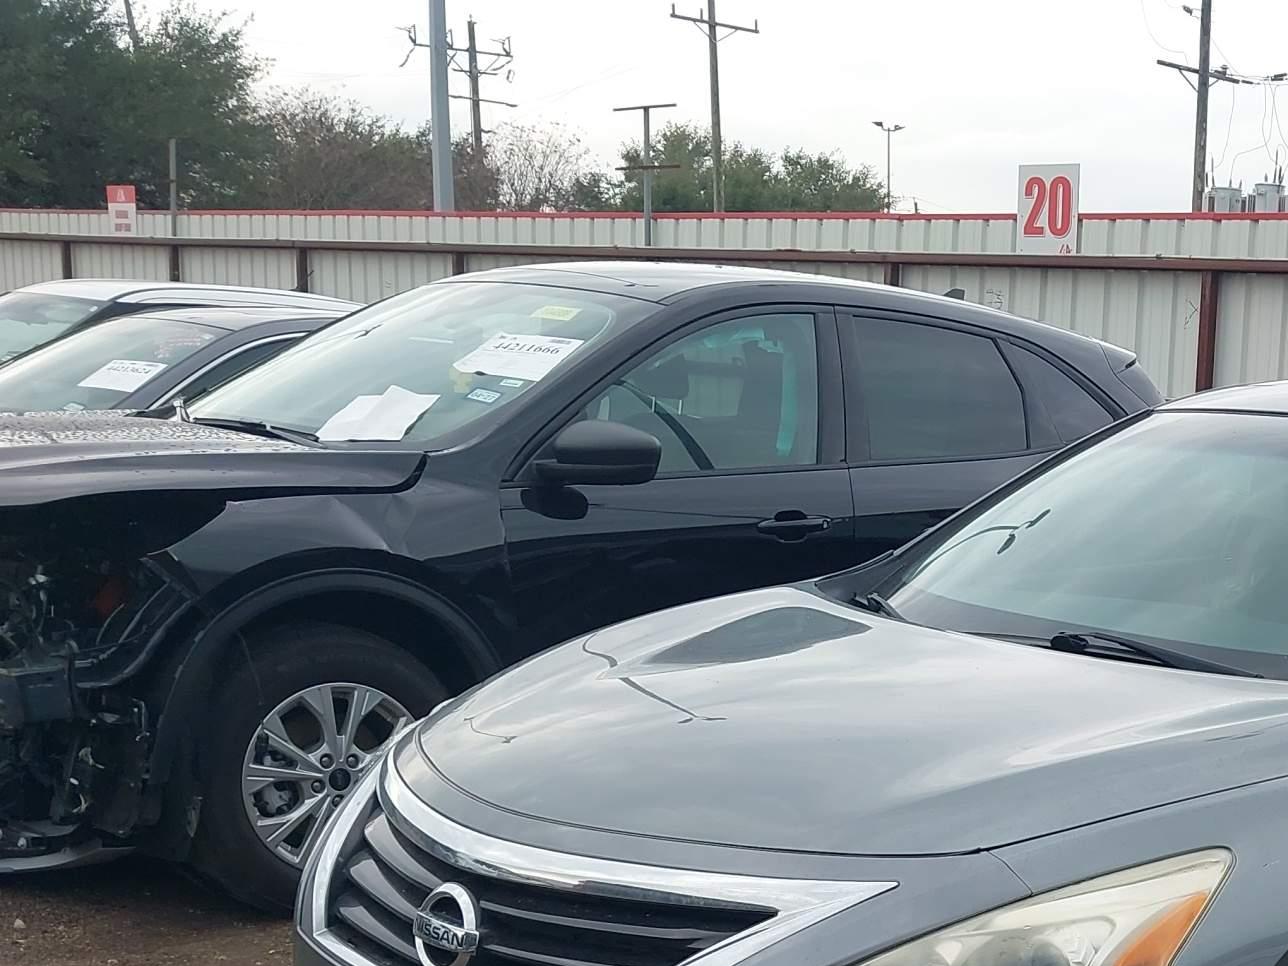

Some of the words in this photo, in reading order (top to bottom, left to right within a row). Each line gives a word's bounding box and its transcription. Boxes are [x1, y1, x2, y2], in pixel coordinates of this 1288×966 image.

[1024, 176, 1072, 238] 20
[493, 342, 560, 355] 44211666
[414, 916, 465, 948] NISSAN
